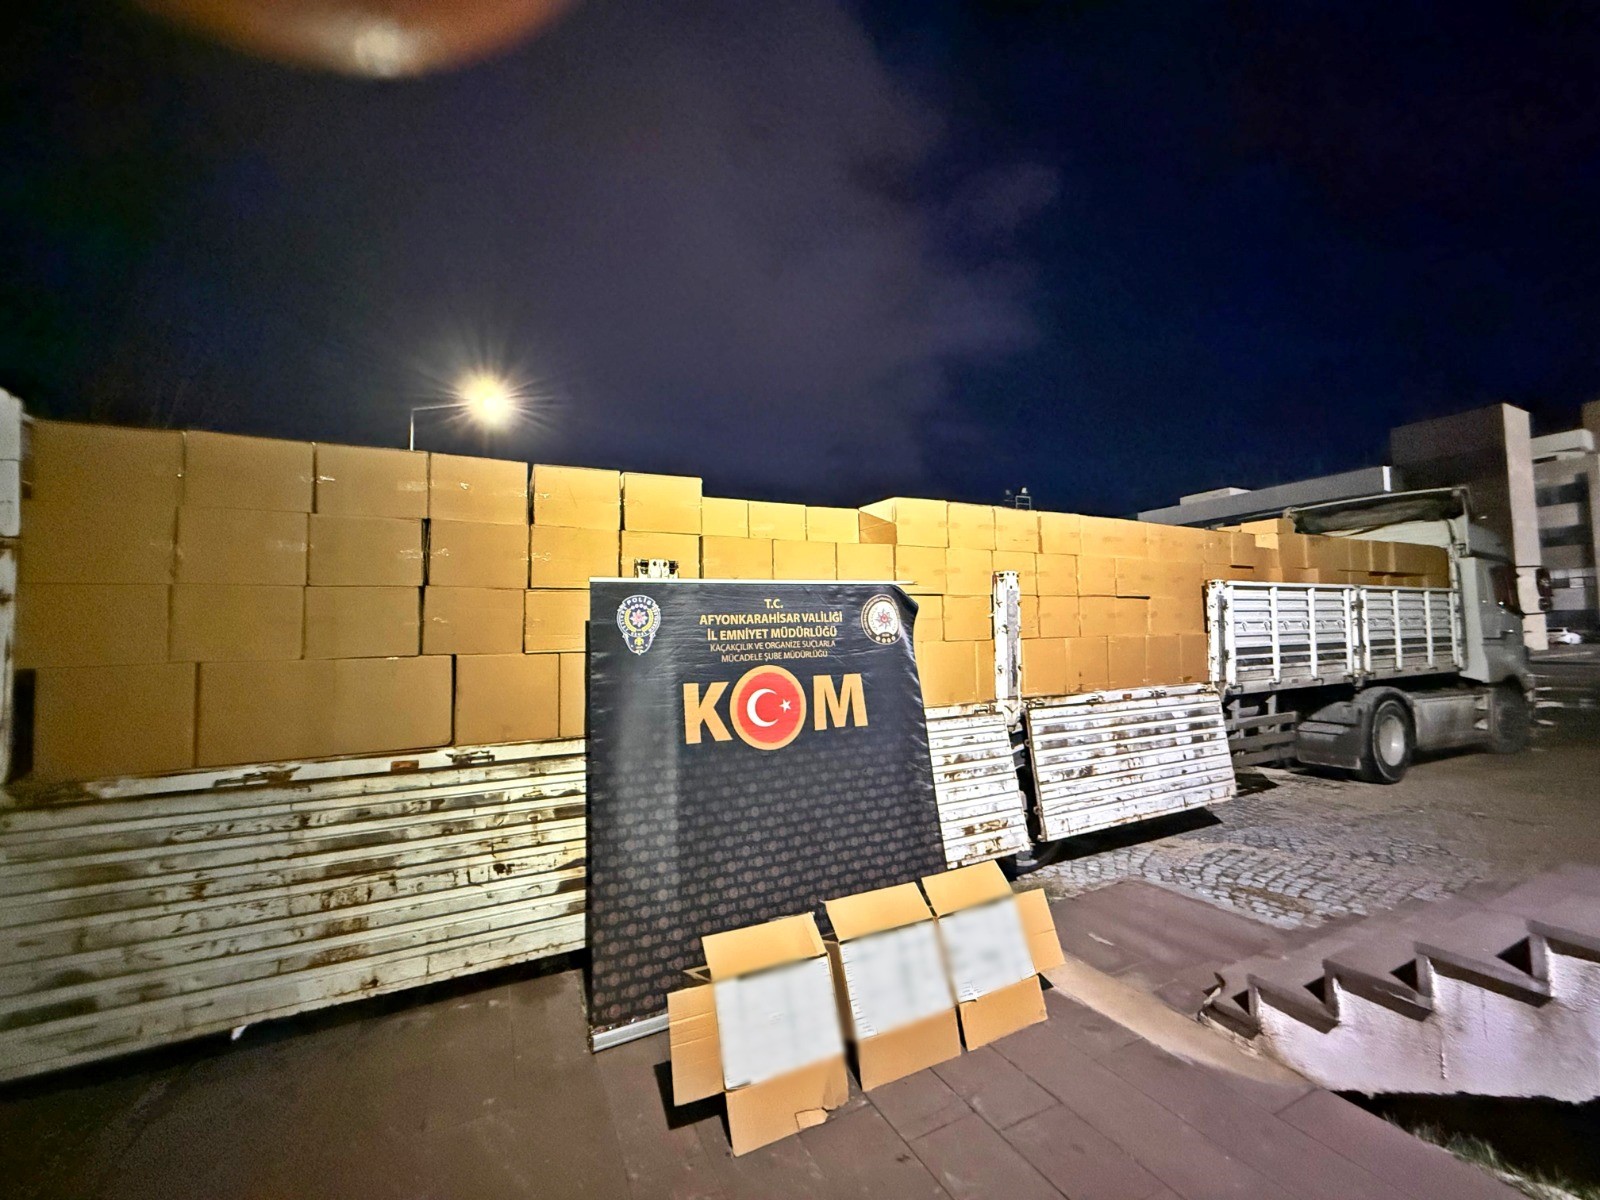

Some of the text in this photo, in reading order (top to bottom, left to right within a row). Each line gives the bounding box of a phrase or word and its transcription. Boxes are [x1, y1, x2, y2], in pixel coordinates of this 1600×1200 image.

[764, 598, 784, 609] T.C.
[699, 610, 843, 626] AFYONKARAHİSAR VALİLİĞİ
[707, 625, 837, 641] İL EMNİYET MÜDÜRLÜĞÜ
[710, 639, 837, 653] KAÇAKÇILIK VE ORGANİZE SUÇLARLA
[721, 649, 828, 664] MÜCADELE ŞUBE MÜDÜRLÜĞÜ
